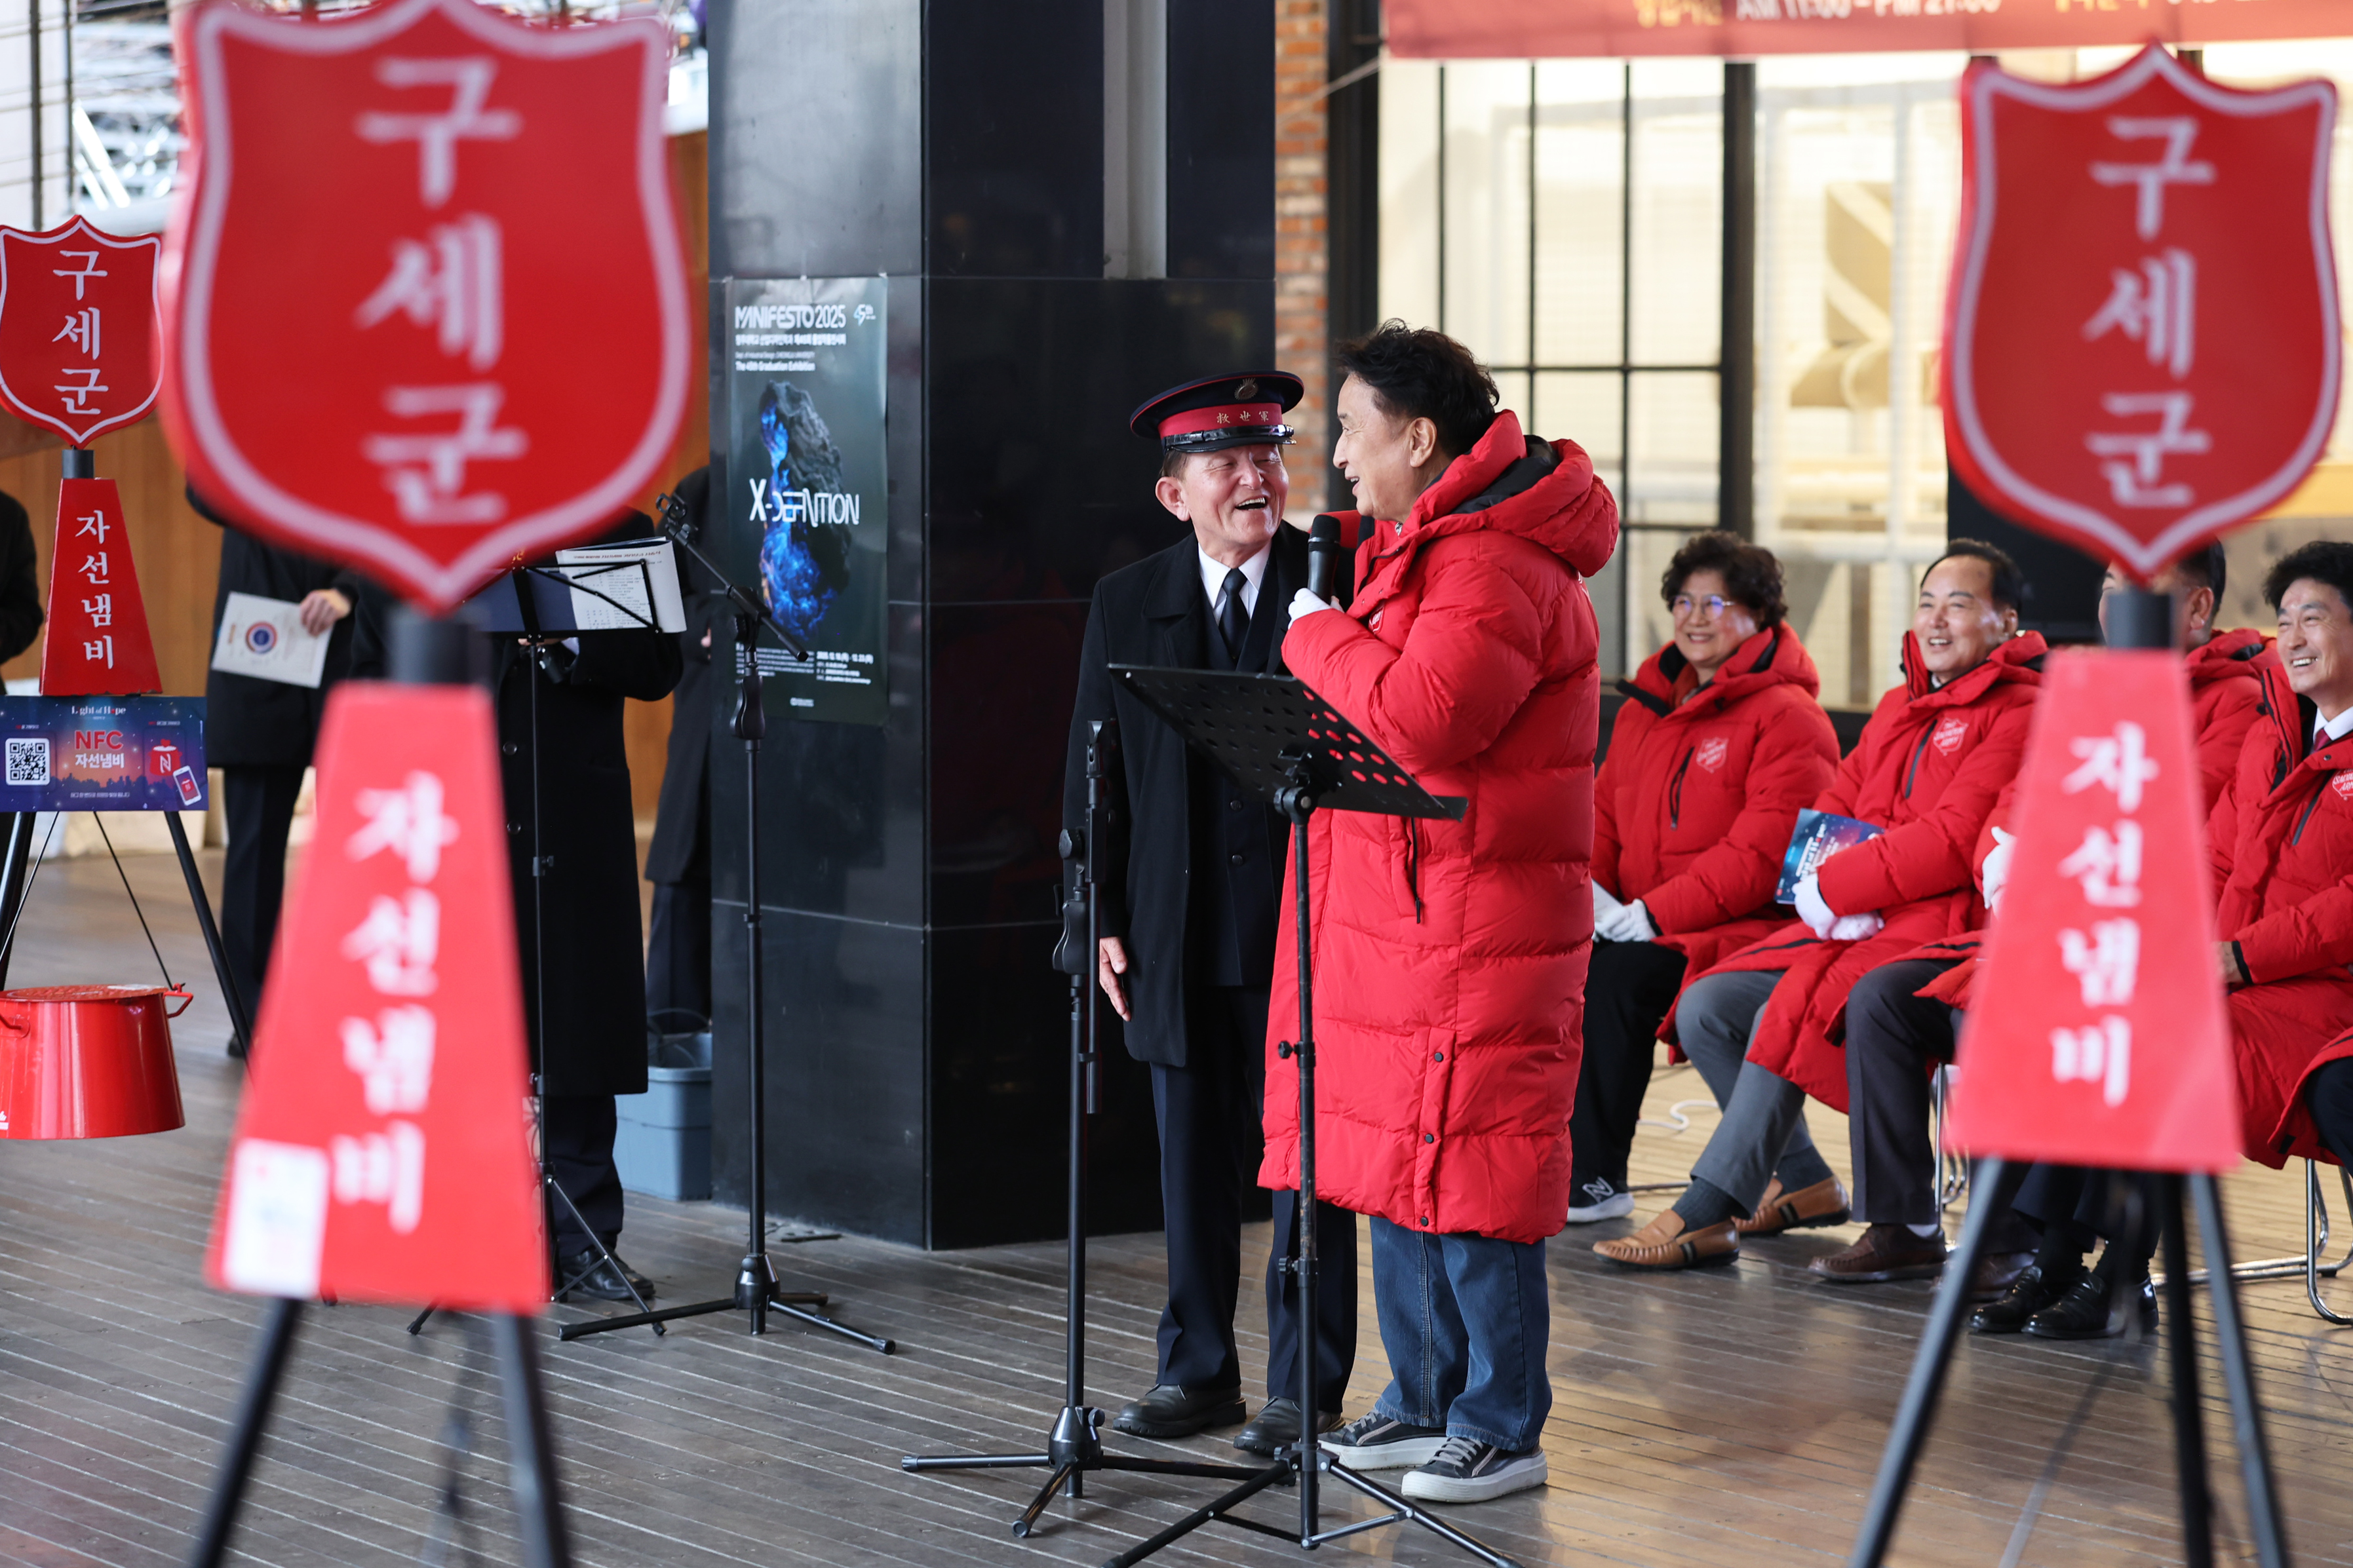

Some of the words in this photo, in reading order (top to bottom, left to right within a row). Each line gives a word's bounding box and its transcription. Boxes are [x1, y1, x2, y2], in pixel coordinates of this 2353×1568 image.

[52, 250, 108, 415] 구세군
[354, 56, 528, 523] 구세군
[735, 305, 815, 329] MANIFESTO
[815, 305, 847, 328] 2025
[2082, 116, 2217, 507] 구세군
[1216, 410, 1269, 424] 救世軍
[75, 509, 114, 670] 자선냄비
[71, 706, 94, 716] Light
[74, 730, 124, 751] NFC
[75, 753, 125, 769] 자선냄비
[2049, 720, 2160, 1107] 자선냄비
[331, 769, 459, 1234] 자선냄비
